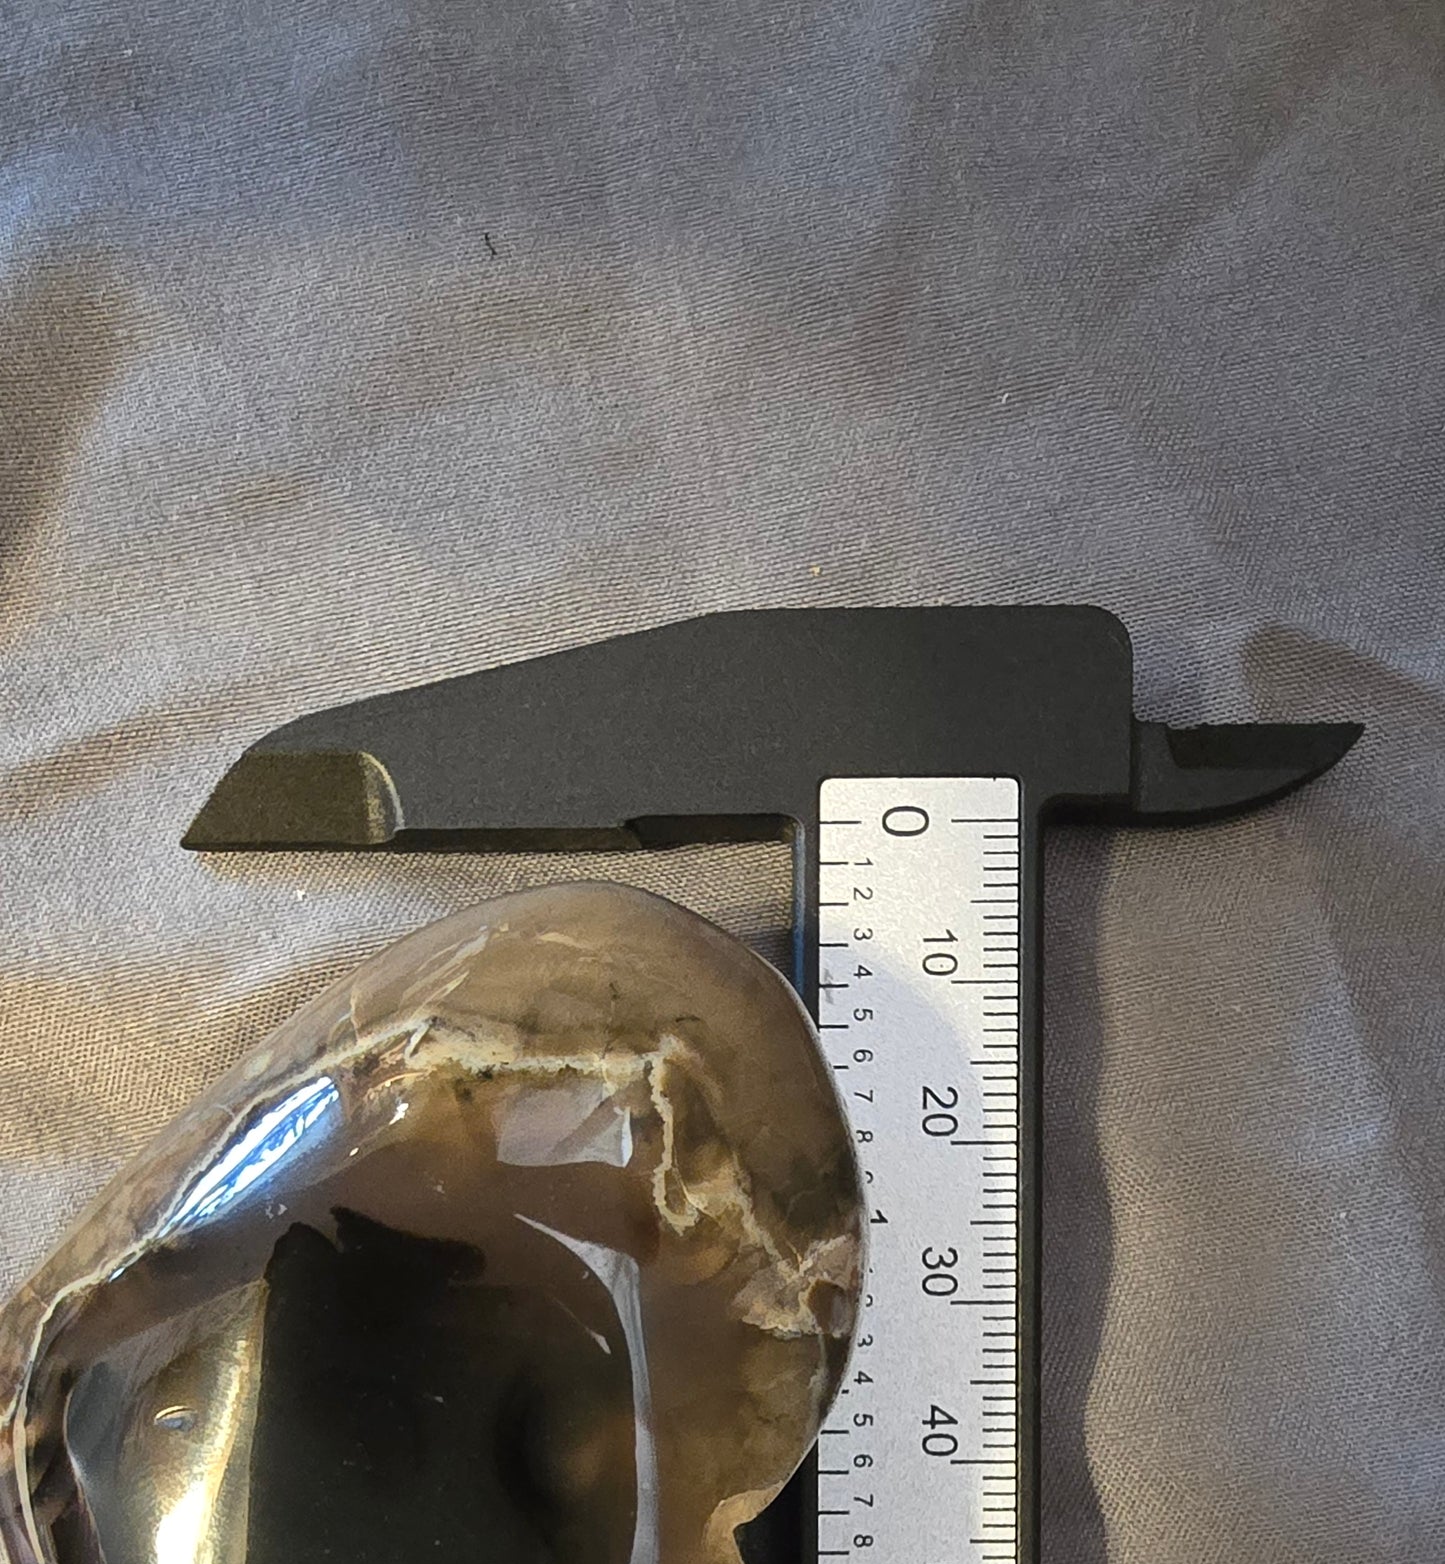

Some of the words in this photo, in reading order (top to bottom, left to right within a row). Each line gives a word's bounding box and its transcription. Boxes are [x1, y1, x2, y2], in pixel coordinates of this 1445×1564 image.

[881, 806, 930, 837] 0
[853, 857, 874, 867] 1
[853, 886, 874, 901] 2
[853, 927, 874, 942] 3
[922, 929, 959, 977] 10
[853, 964, 874, 980] 4
[853, 1007, 874, 1022] 5
[853, 1048, 874, 1063] 6
[853, 1089, 874, 1104] 7
[922, 1086, 959, 1138] 20
[856, 1129, 874, 1144] 8
[922, 1246, 959, 1297] 30
[858, 1333, 874, 1348] 3
[853, 1370, 874, 1386] 4
[853, 1412, 874, 1428] 5
[922, 1404, 959, 1457] 40
[853, 1453, 874, 1469] 6
[853, 1493, 874, 1508] 7
[853, 1533, 874, 1549] 8
